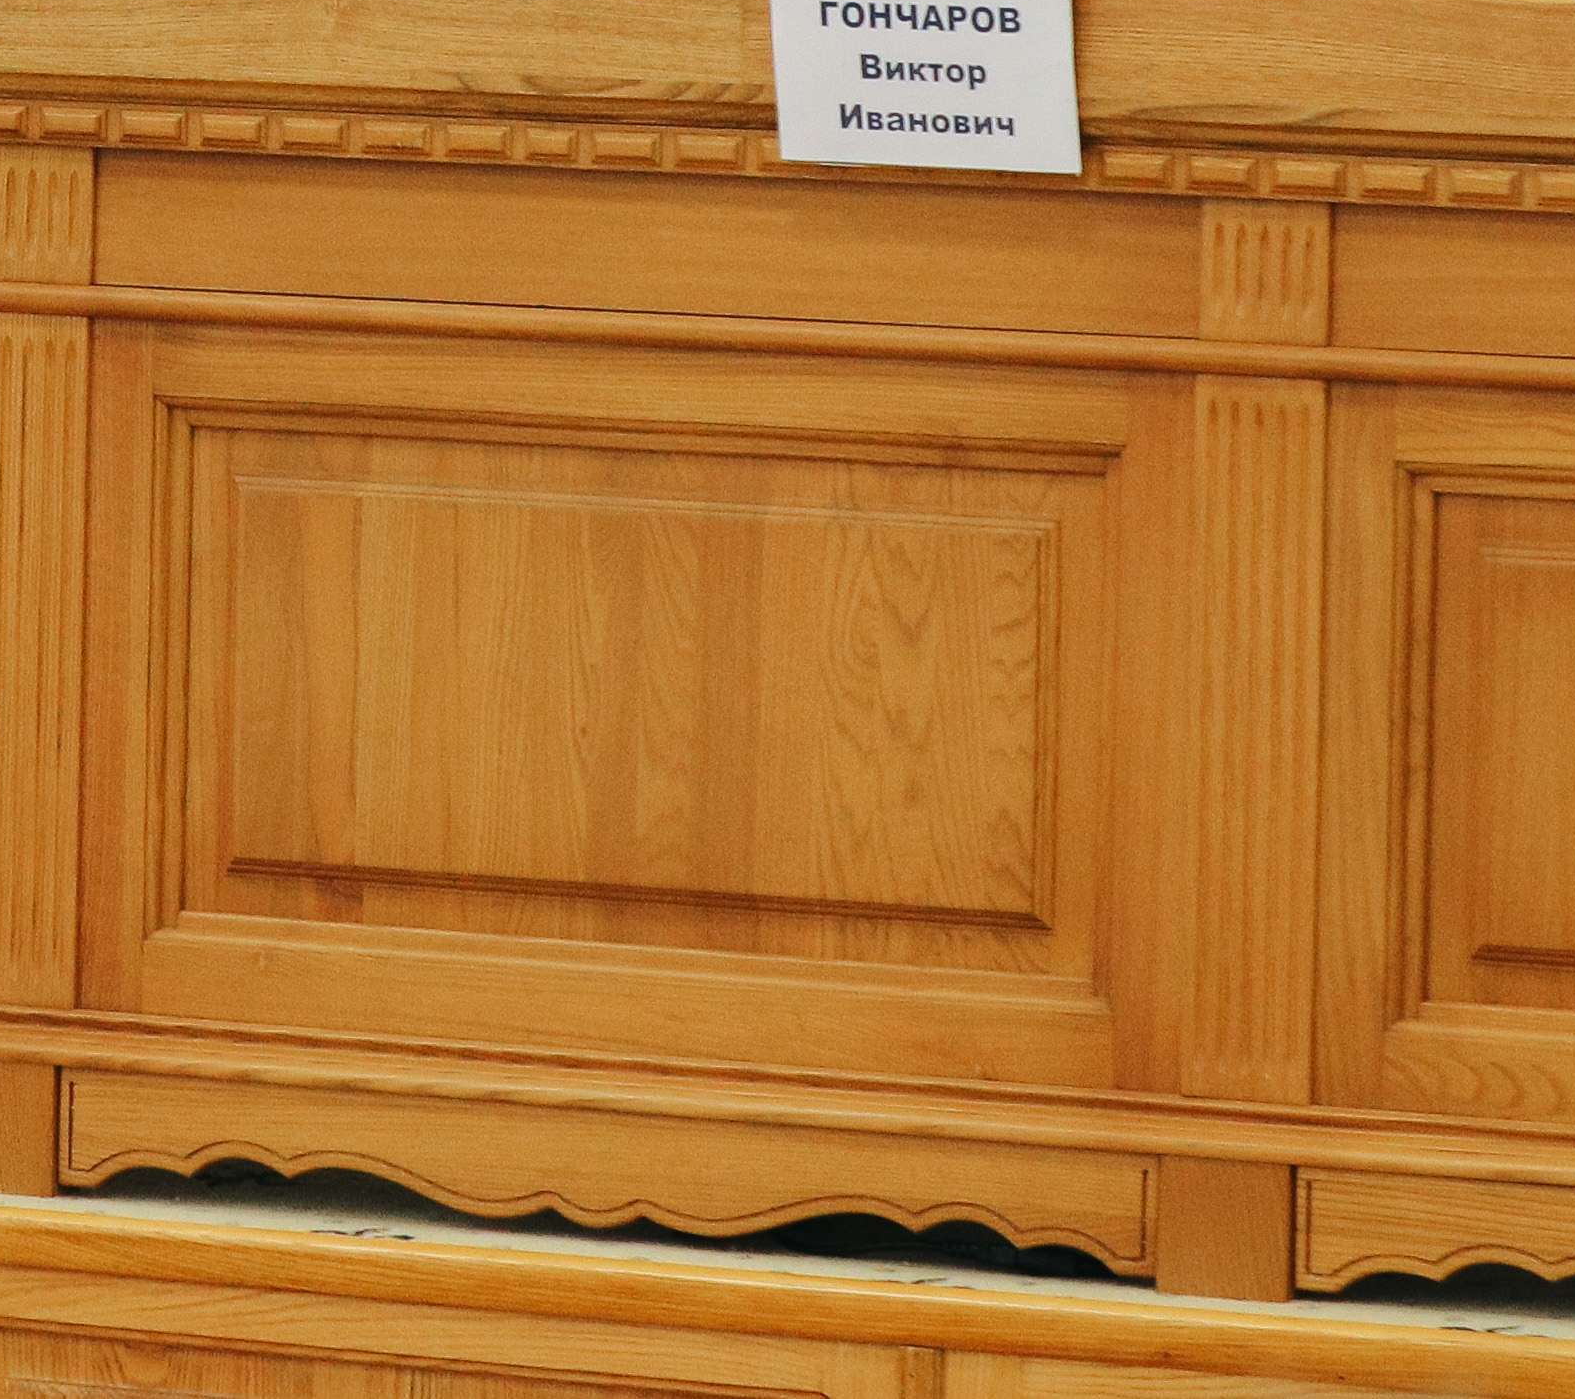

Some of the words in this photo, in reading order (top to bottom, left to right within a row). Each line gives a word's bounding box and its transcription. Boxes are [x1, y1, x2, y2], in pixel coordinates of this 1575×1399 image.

[819, 0, 1021, 33] ГОНЧАРОВ
[860, 53, 987, 89] Виктор
[839, 103, 1015, 136] Иванович
